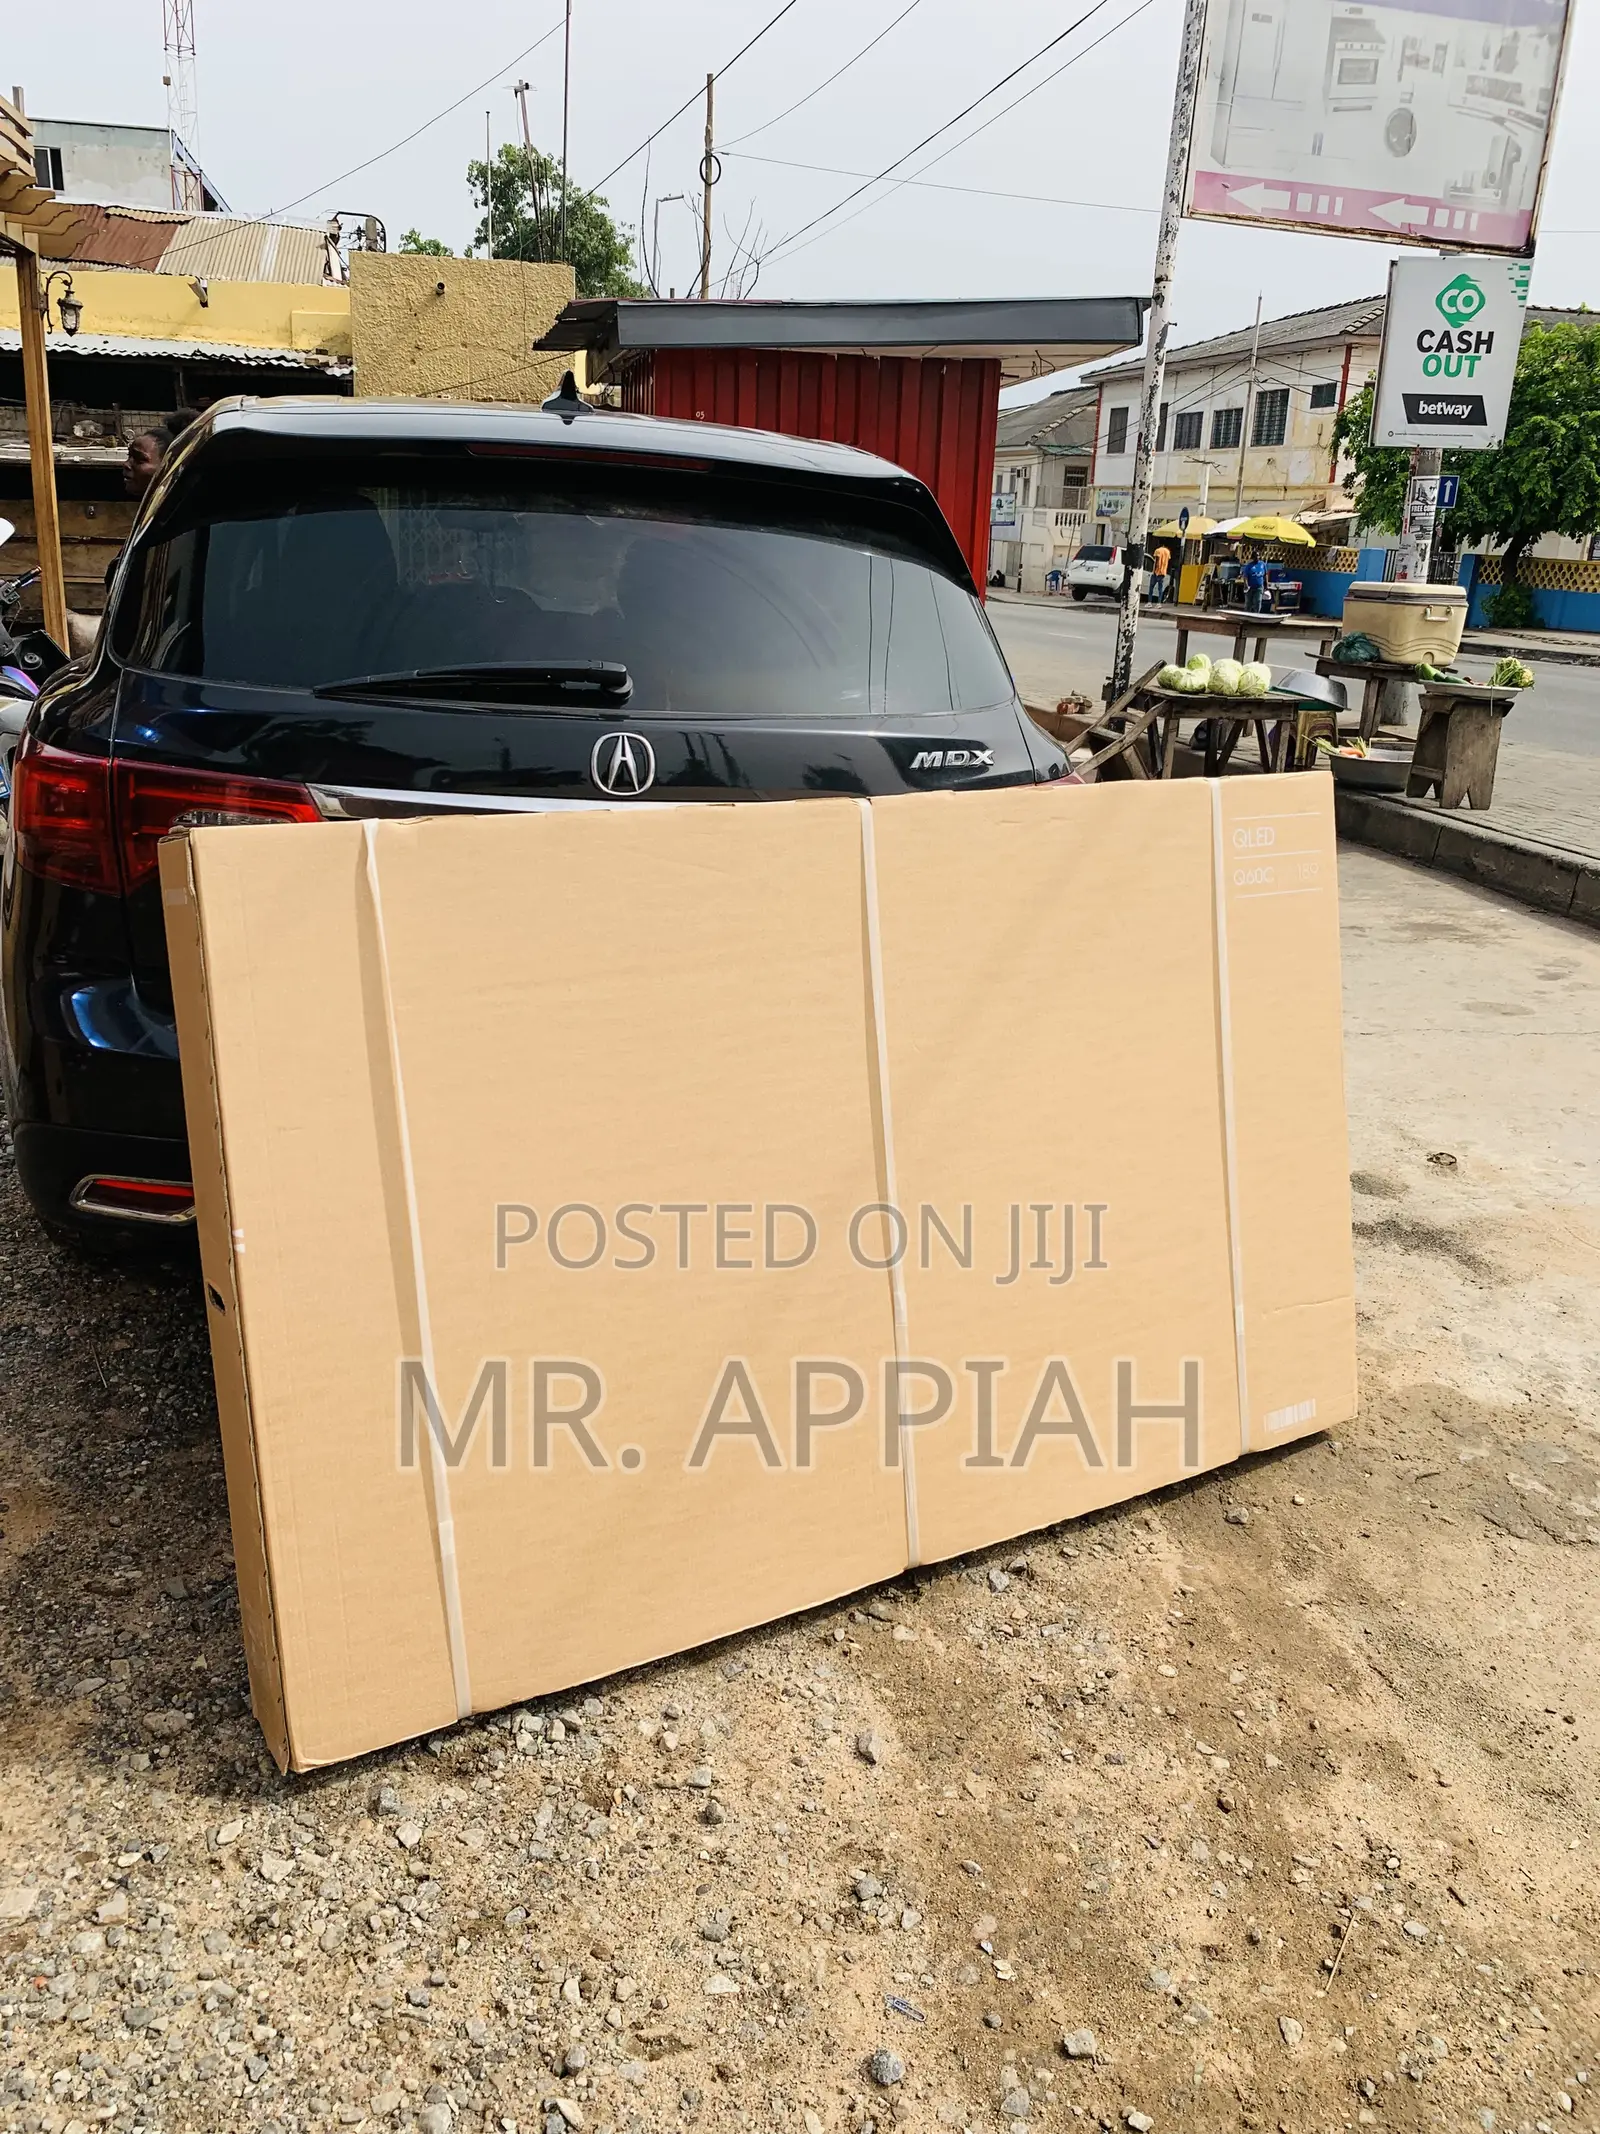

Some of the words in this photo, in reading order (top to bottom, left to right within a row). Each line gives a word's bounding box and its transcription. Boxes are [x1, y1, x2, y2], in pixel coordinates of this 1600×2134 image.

[1441, 288, 1480, 315] CO
[1416, 329, 1495, 354] CASH
[1422, 353, 1482, 378] OUT
[1418, 400, 1472, 419] betway
[909, 749, 994, 770] MDX
[1232, 826, 1275, 848] QLED
[1233, 866, 1275, 886] Q60C
